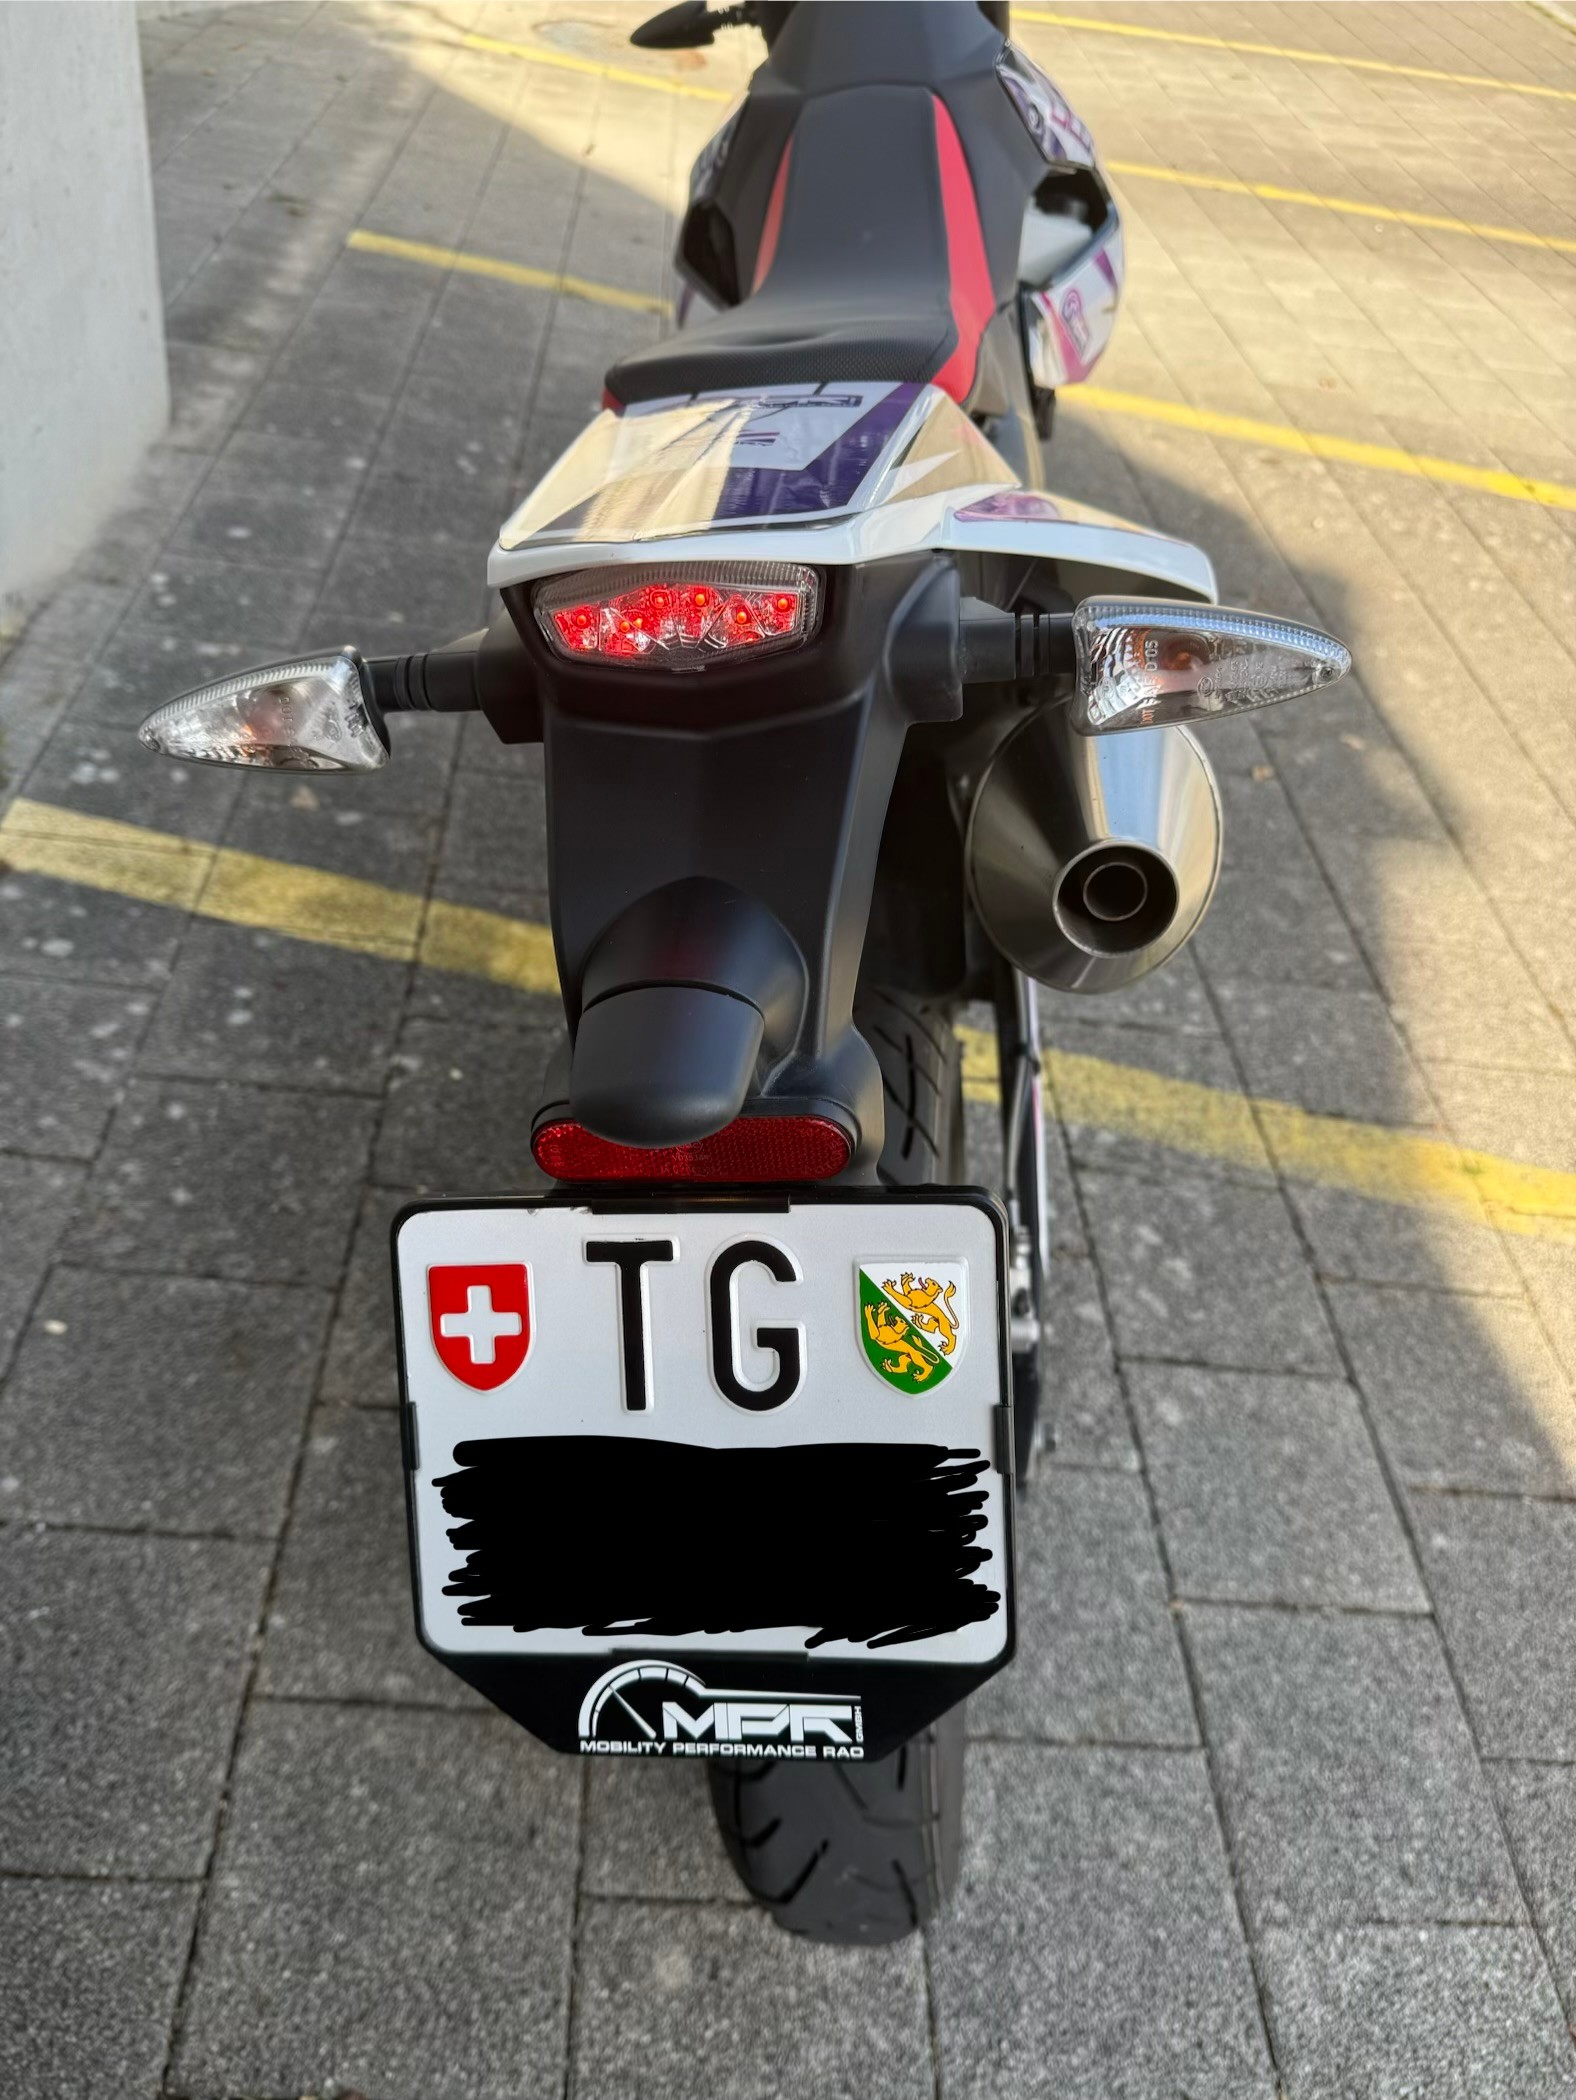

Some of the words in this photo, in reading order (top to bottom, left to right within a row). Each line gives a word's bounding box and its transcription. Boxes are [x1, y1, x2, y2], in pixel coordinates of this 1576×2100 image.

[586, 1240, 798, 1412] TG
[661, 1701, 852, 1743] MPR
[854, 1705, 864, 1743] GMBH
[579, 1740, 667, 1754] MOBILITY
[672, 1742, 817, 1758] PERFORMANCE
